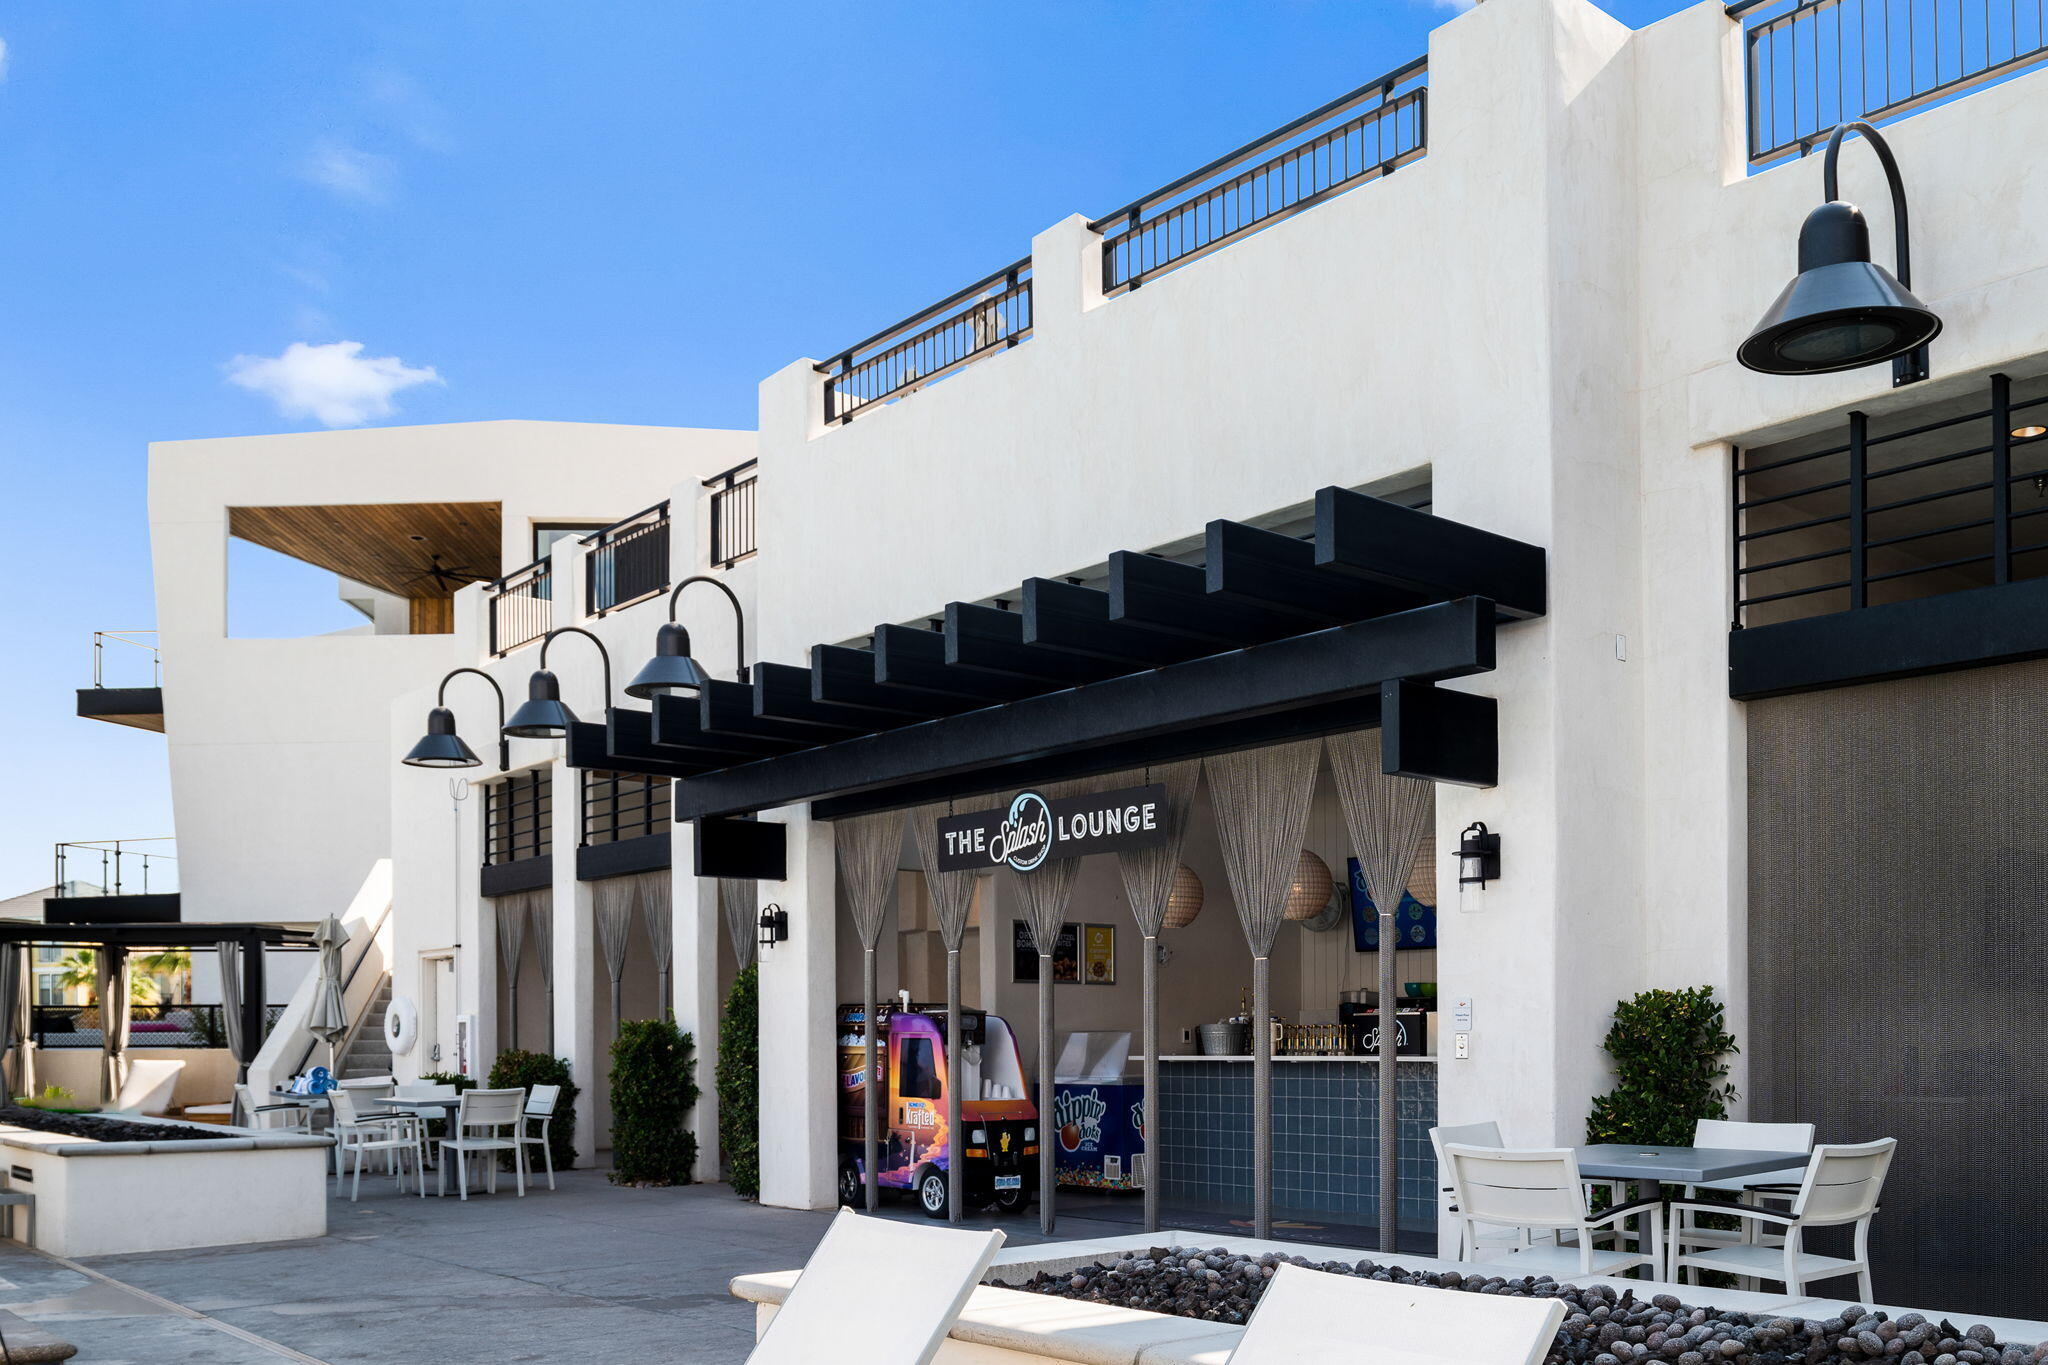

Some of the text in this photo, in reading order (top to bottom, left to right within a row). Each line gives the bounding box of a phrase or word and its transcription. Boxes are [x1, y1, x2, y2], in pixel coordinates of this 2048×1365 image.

[945, 803, 1156, 863] THE Splash LOUNGE
[1079, 1122, 1102, 1143] dots
